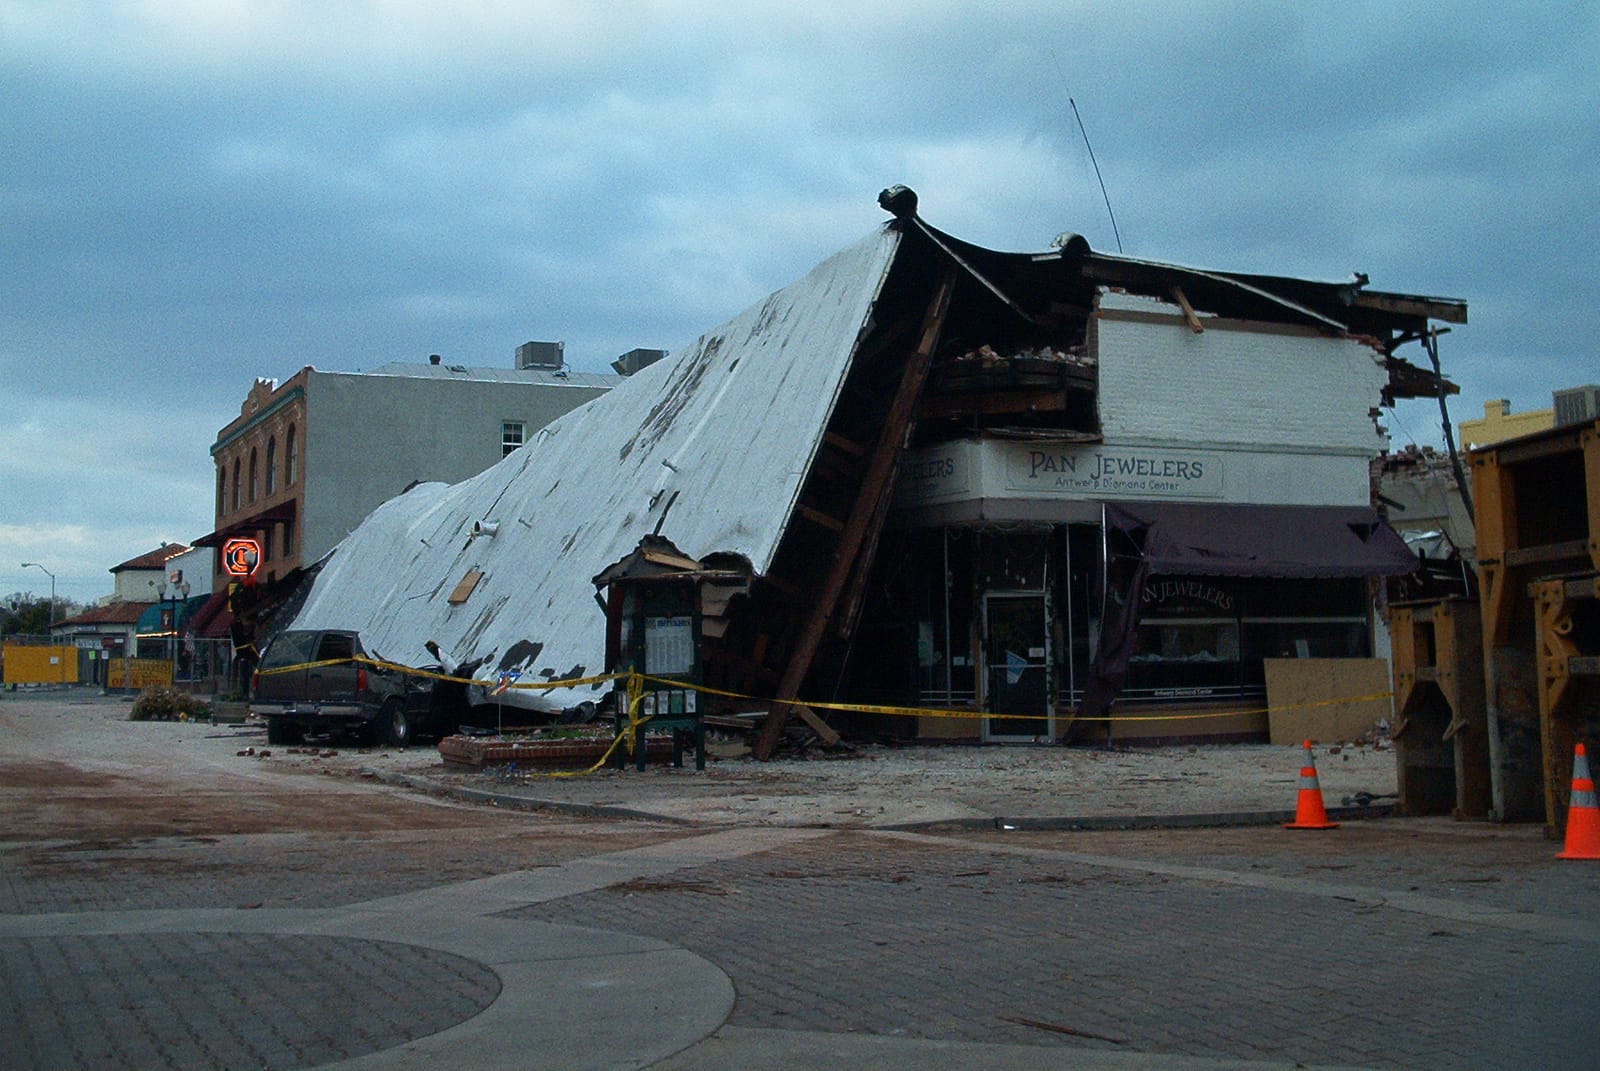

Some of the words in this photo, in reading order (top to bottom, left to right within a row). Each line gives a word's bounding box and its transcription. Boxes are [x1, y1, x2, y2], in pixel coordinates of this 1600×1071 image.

[1028, 450, 1078, 479] PAN
[1089, 453, 1203, 480] JEWELERS
[1055, 477, 1100, 490] Antwerp
[1103, 478, 1146, 490] Diamond
[1148, 480, 1179, 491] Center
[1158, 579, 1233, 610] JEWELERS
